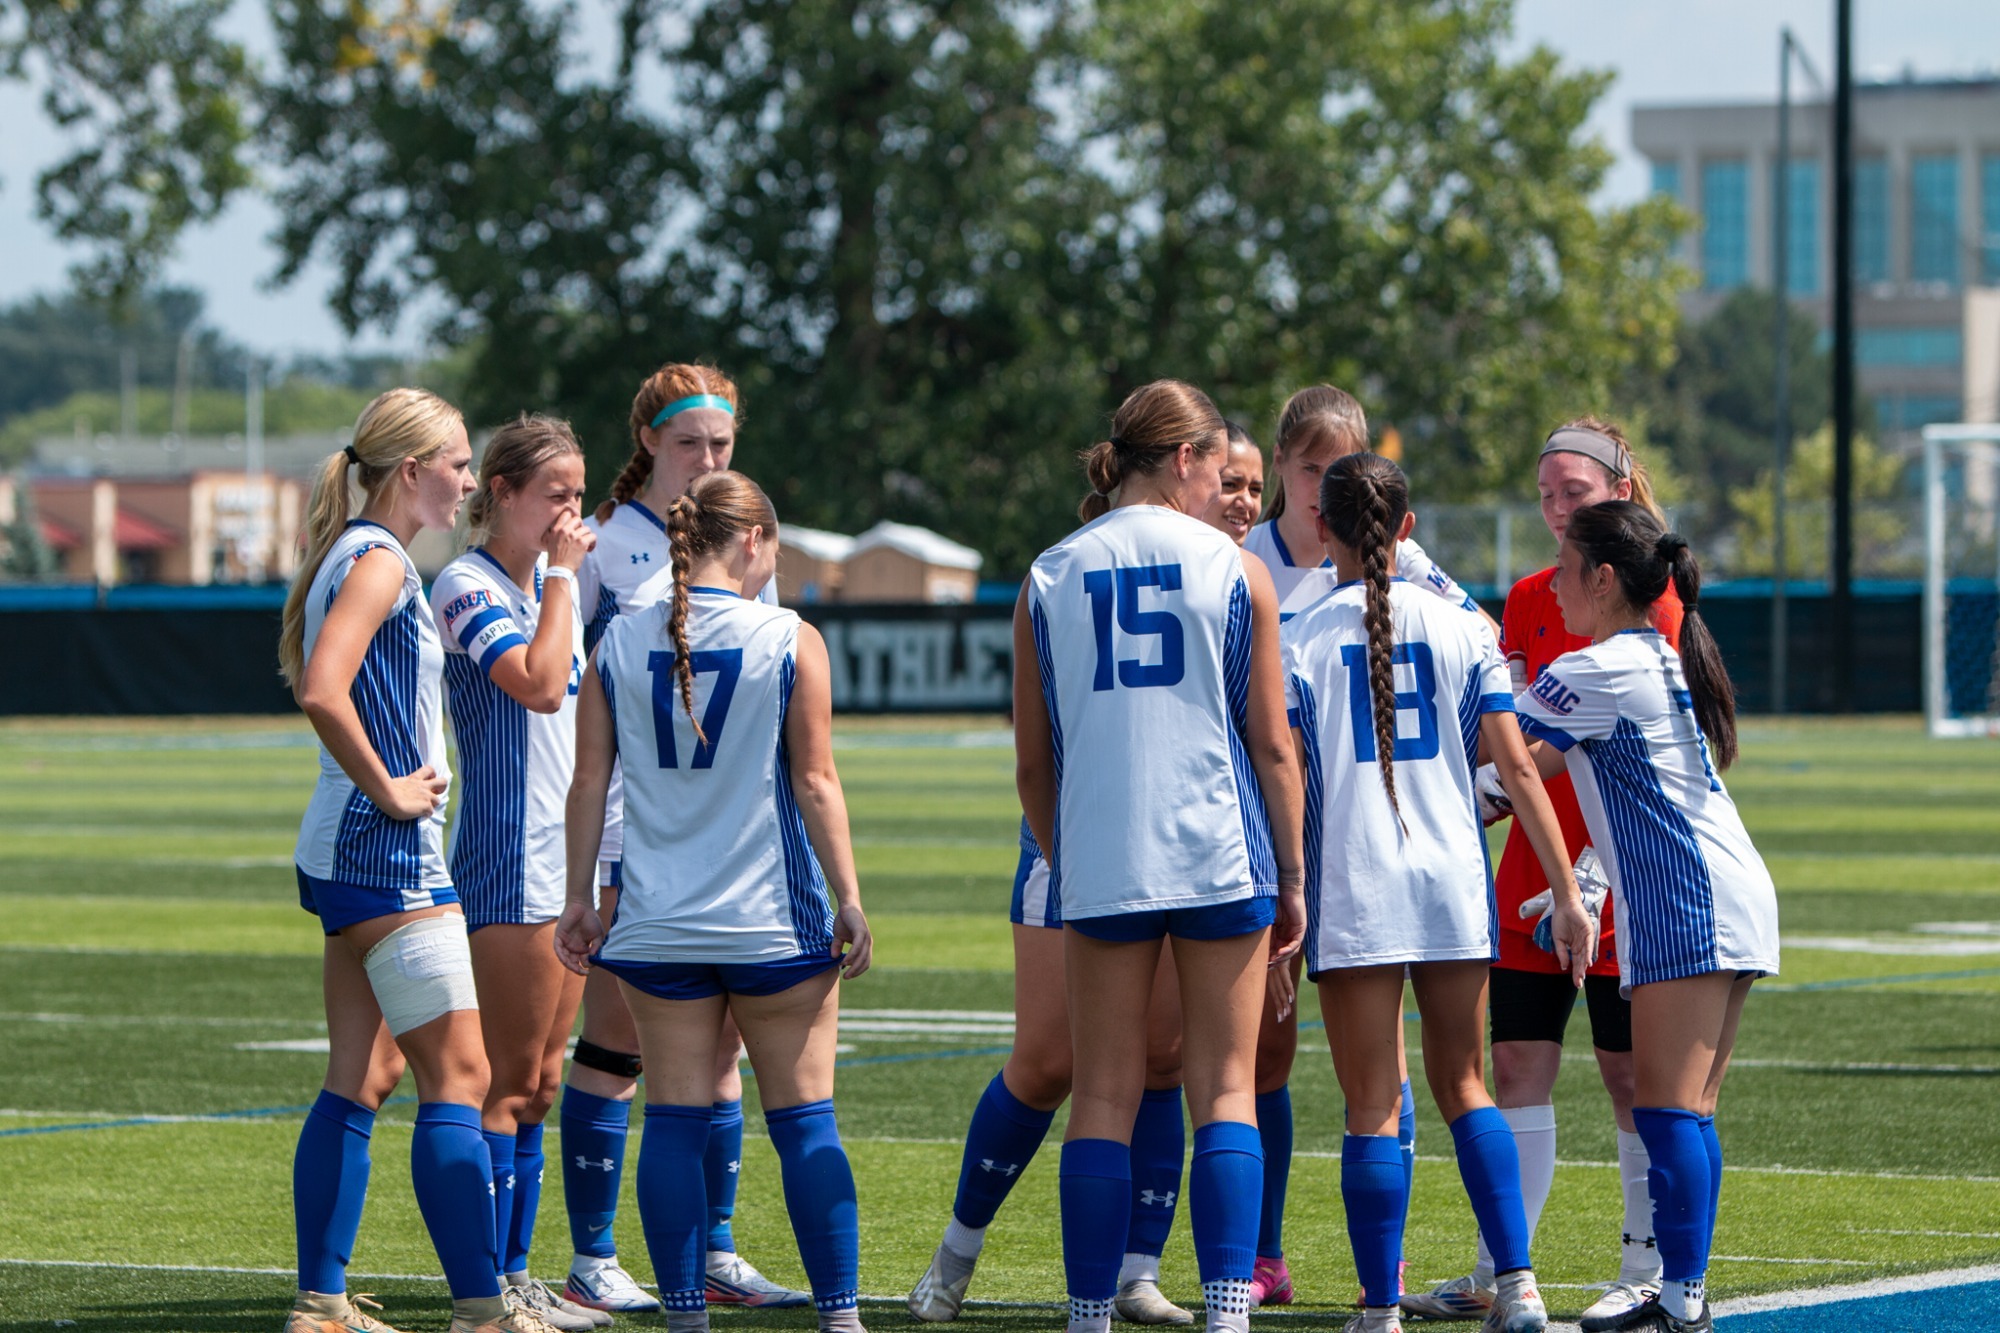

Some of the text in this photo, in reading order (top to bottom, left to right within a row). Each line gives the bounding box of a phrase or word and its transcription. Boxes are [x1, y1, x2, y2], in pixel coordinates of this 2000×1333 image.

[443, 590, 491, 620] NAIA
[479, 622, 513, 646] CAPTA
[1083, 563, 1185, 692] 15
[647, 648, 743, 769] 17
[823, 620, 1015, 706] ATHLE
[1340, 642, 1440, 763] 18
